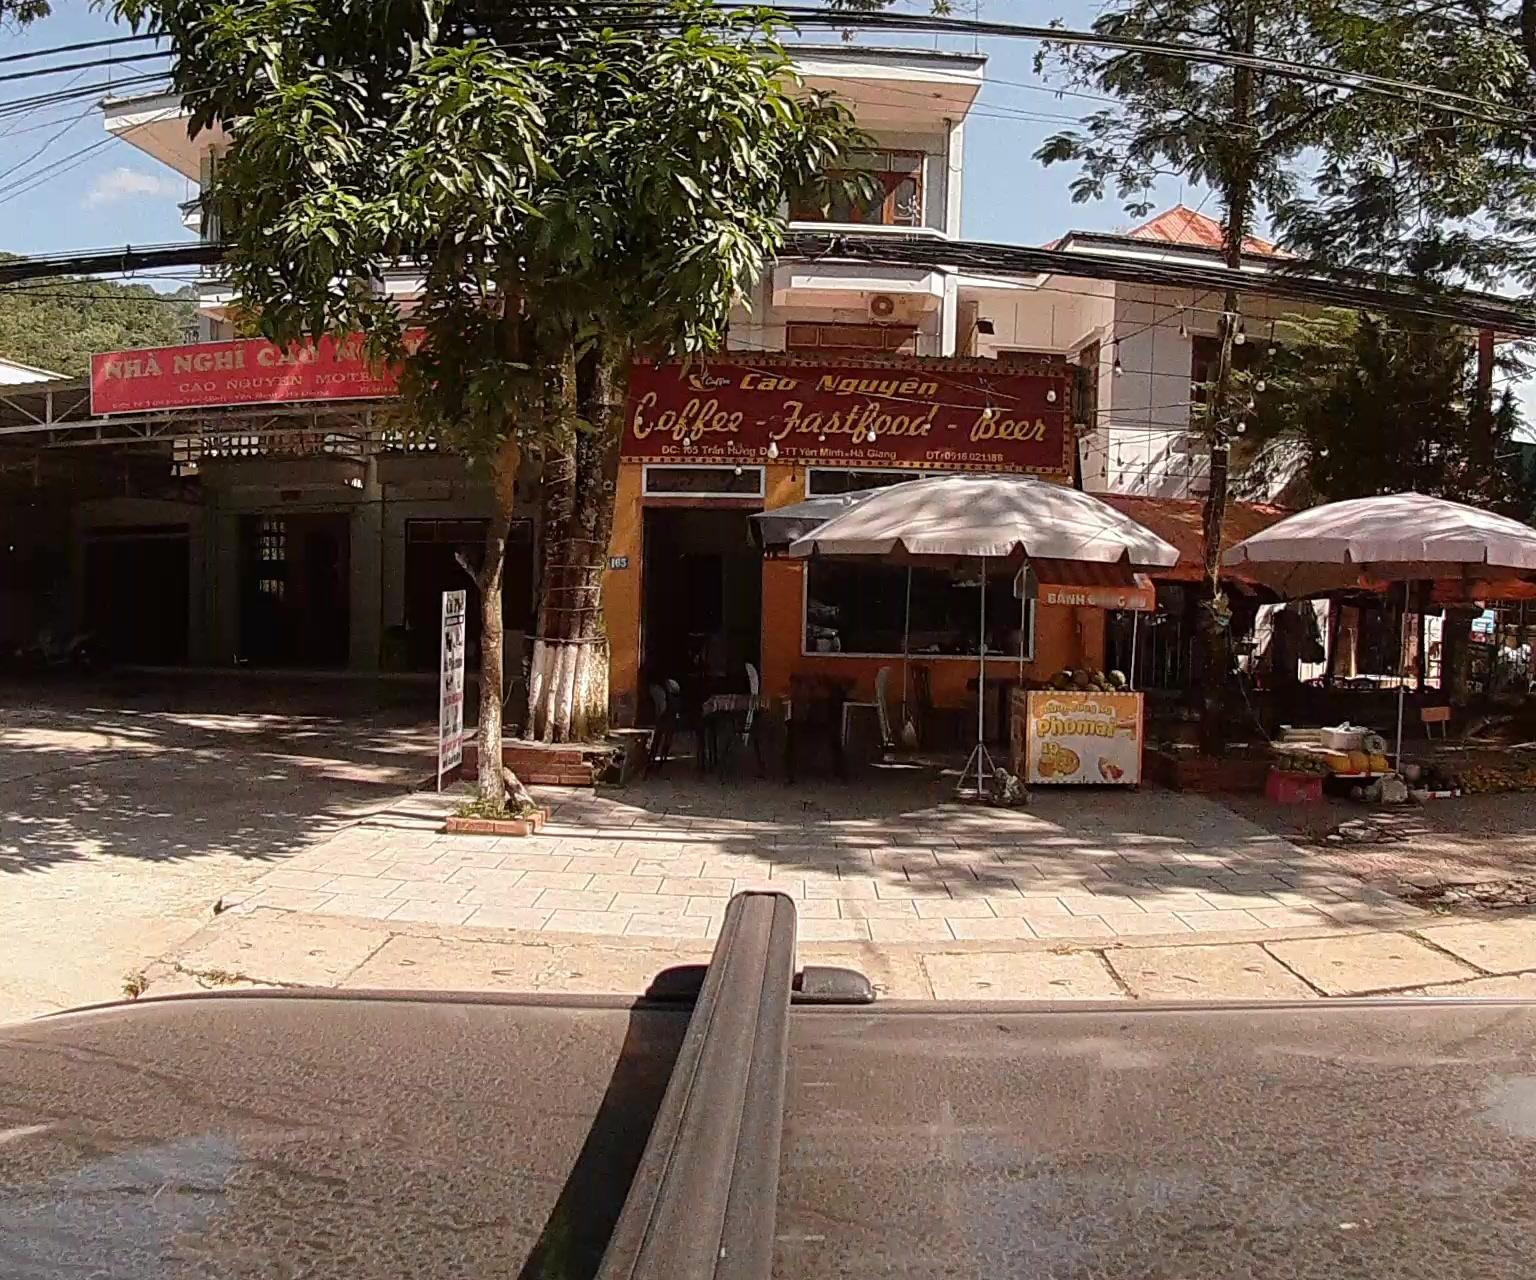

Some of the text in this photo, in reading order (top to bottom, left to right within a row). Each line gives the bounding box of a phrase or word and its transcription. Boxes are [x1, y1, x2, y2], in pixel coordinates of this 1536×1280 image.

[104, 351, 163, 381] NHÀ
[179, 381, 216, 393] CAO
[739, 373, 797, 391] Cao
[815, 374, 939, 398] Nguyên
[633, 391, 744, 441] Coffee
[970, 409, 1047, 443] Beer
[867, 448, 897, 460] Giang
